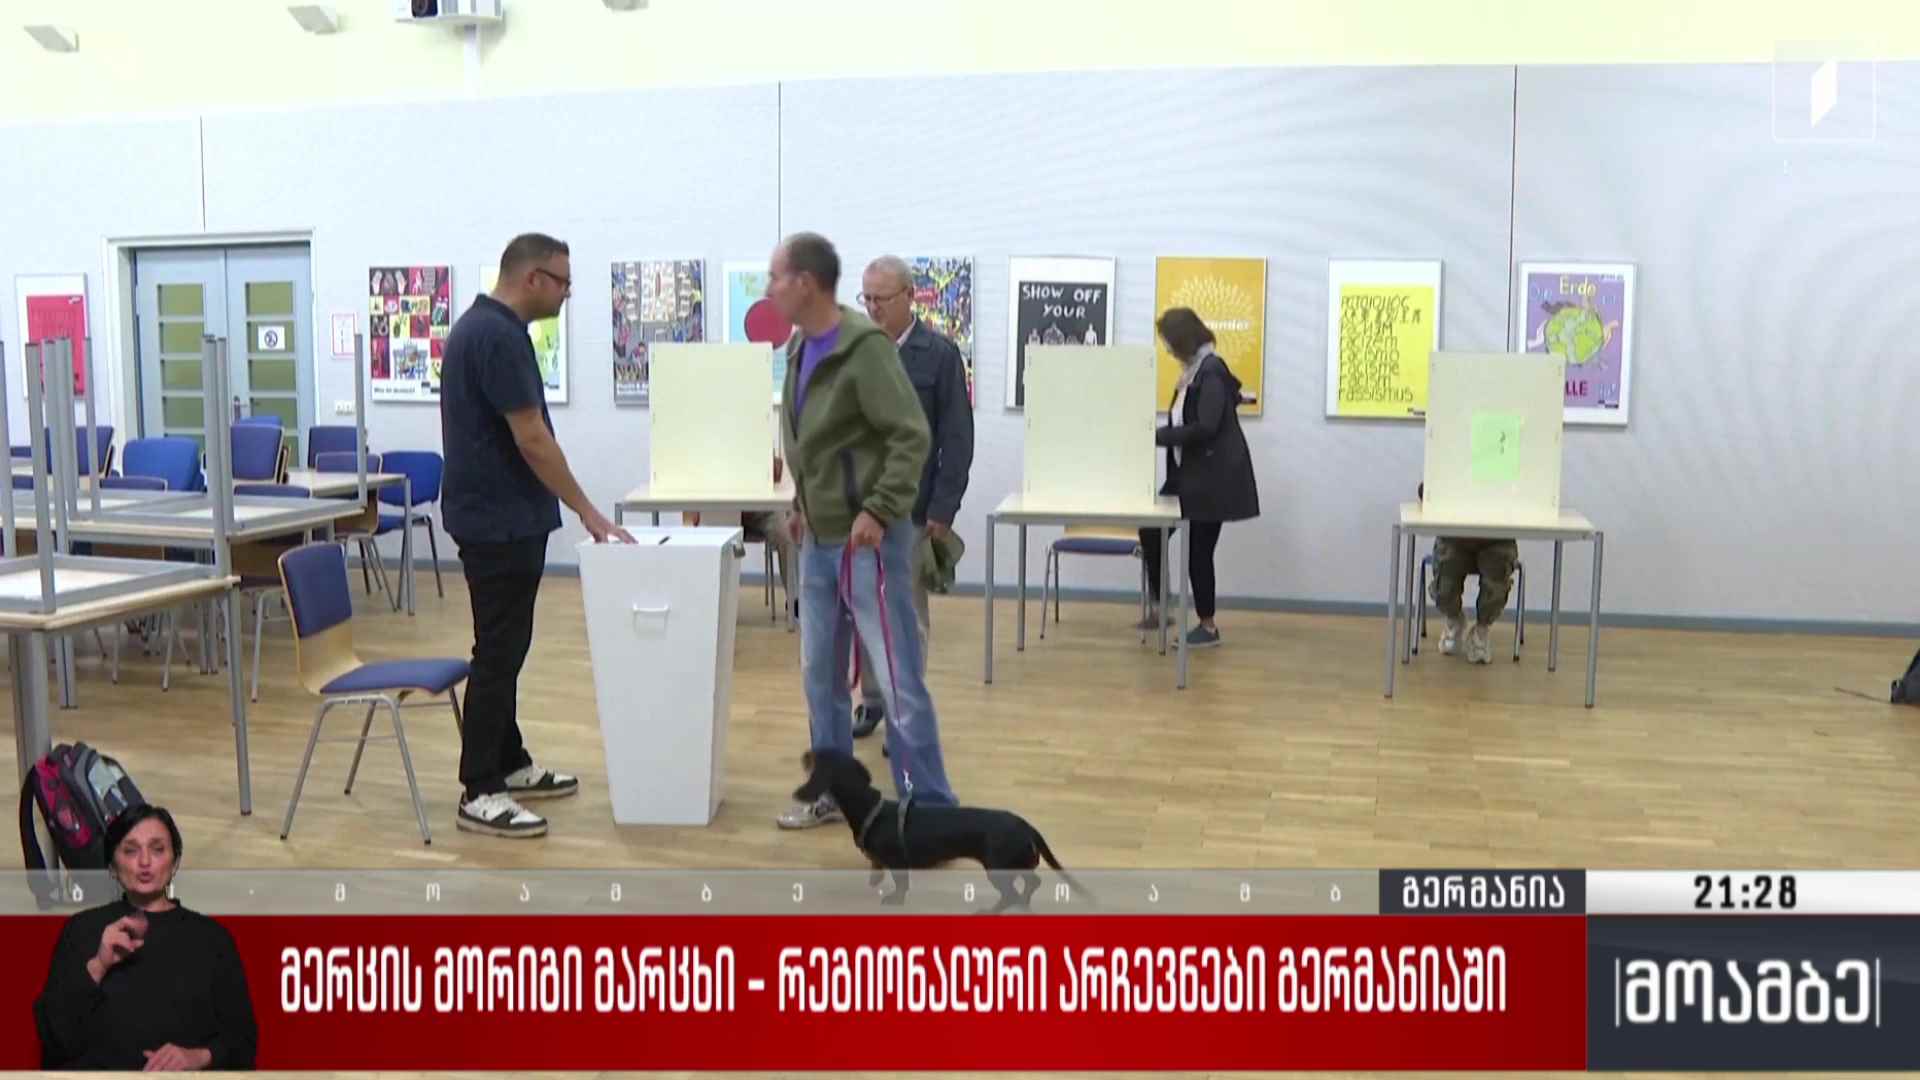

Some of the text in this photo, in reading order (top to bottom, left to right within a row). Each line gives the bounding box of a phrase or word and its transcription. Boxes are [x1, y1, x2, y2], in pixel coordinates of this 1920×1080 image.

[1022, 284, 1102, 304] SHOW OFF
[1559, 276, 1597, 297] Erde
[1042, 303, 1086, 319] YOUR
[1565, 380, 1589, 397] LLE
